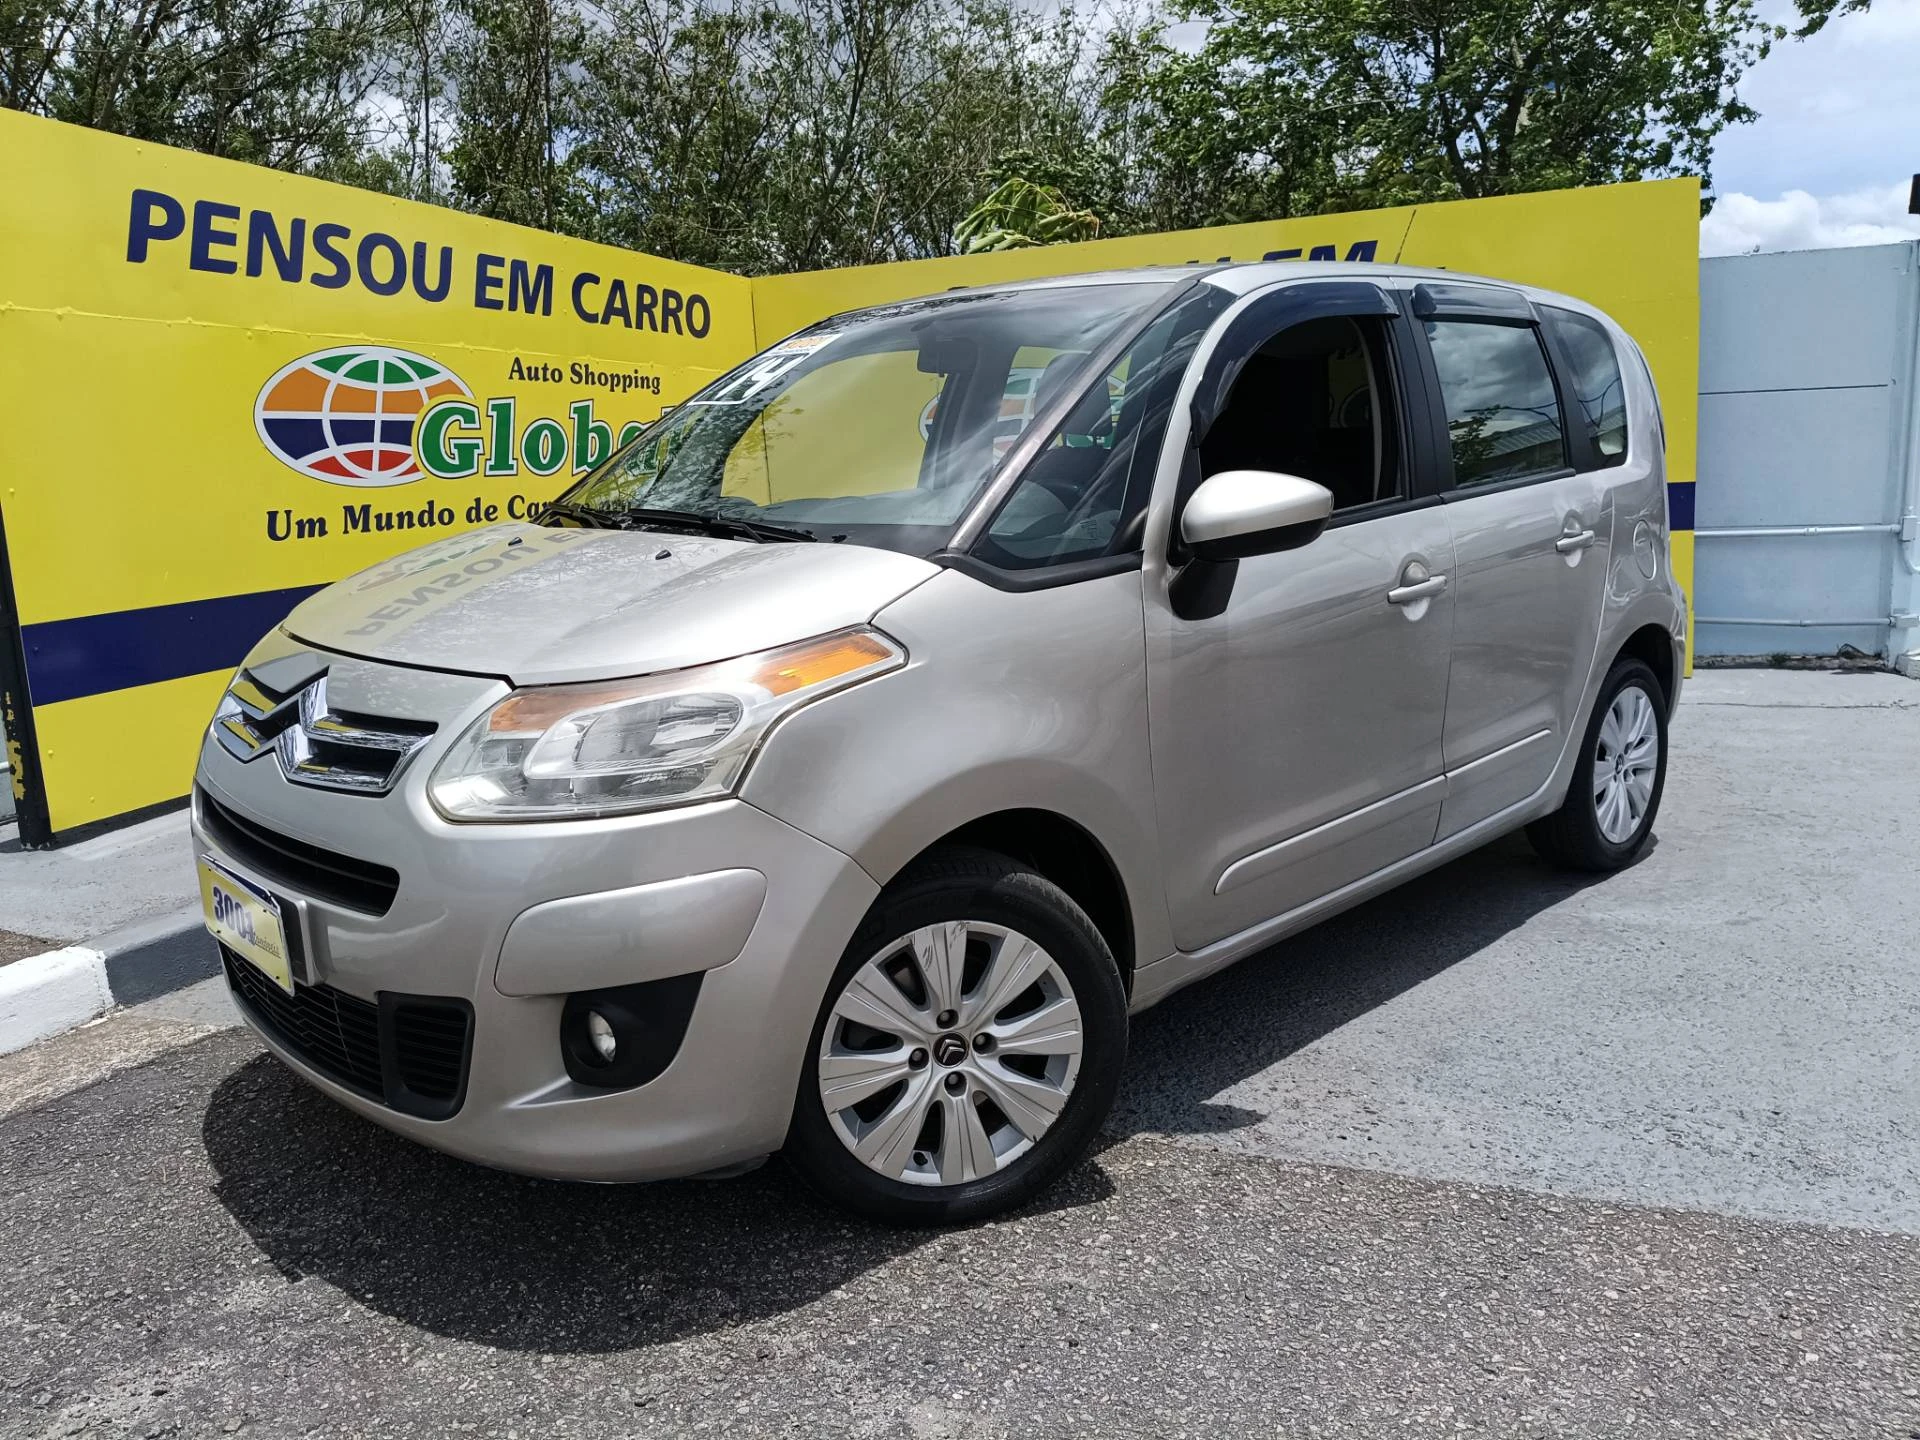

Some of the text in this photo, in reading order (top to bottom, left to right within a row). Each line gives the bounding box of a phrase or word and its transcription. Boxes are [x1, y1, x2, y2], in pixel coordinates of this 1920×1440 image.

[126, 188, 711, 339] PENSOU EM CARRO
[508, 357, 661, 395] Auto Shopping
[266, 509, 329, 542] Um
[342, 499, 455, 535] Mundo
[465, 495, 499, 524] de
